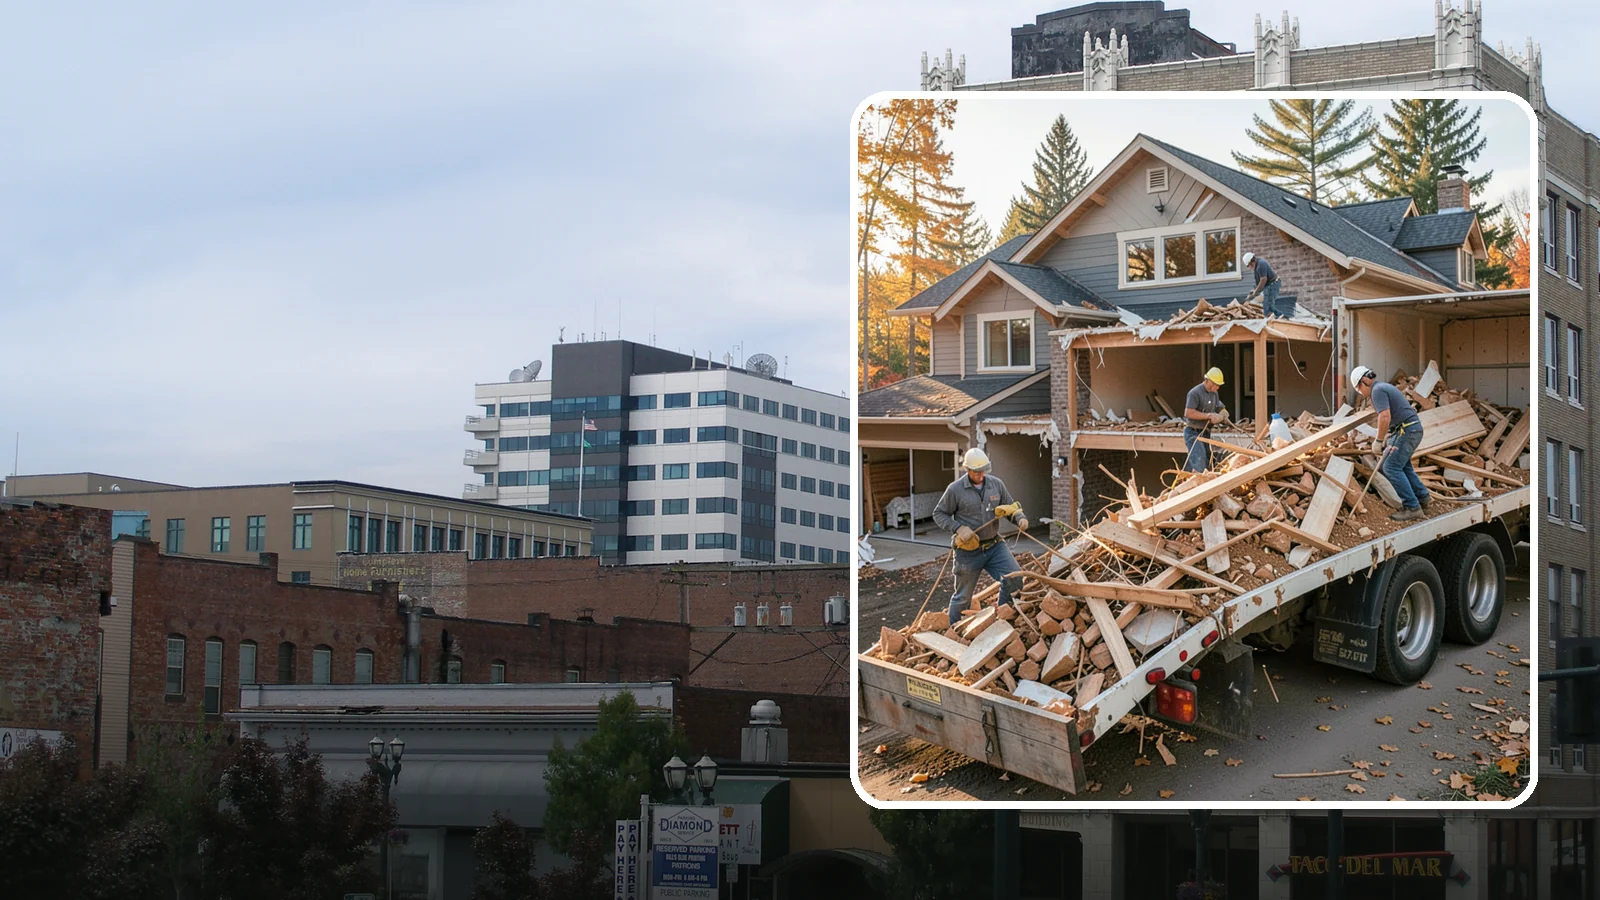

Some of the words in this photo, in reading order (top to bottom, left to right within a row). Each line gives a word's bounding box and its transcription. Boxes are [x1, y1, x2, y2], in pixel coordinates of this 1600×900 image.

[660, 818, 713, 833] DIAMOND
[1022, 815, 1070, 828] BUILDING
[656, 845, 688, 853] RESERVED
[689, 846, 716, 854] PARKING
[671, 862, 701, 870] PATRONS
[1289, 855, 1330, 875] TAC
[1345, 856, 1385, 876] DEL
[1391, 857, 1443, 877] MAR
[660, 888, 682, 897] PUBLIC
[684, 890, 710, 898] PARKING
